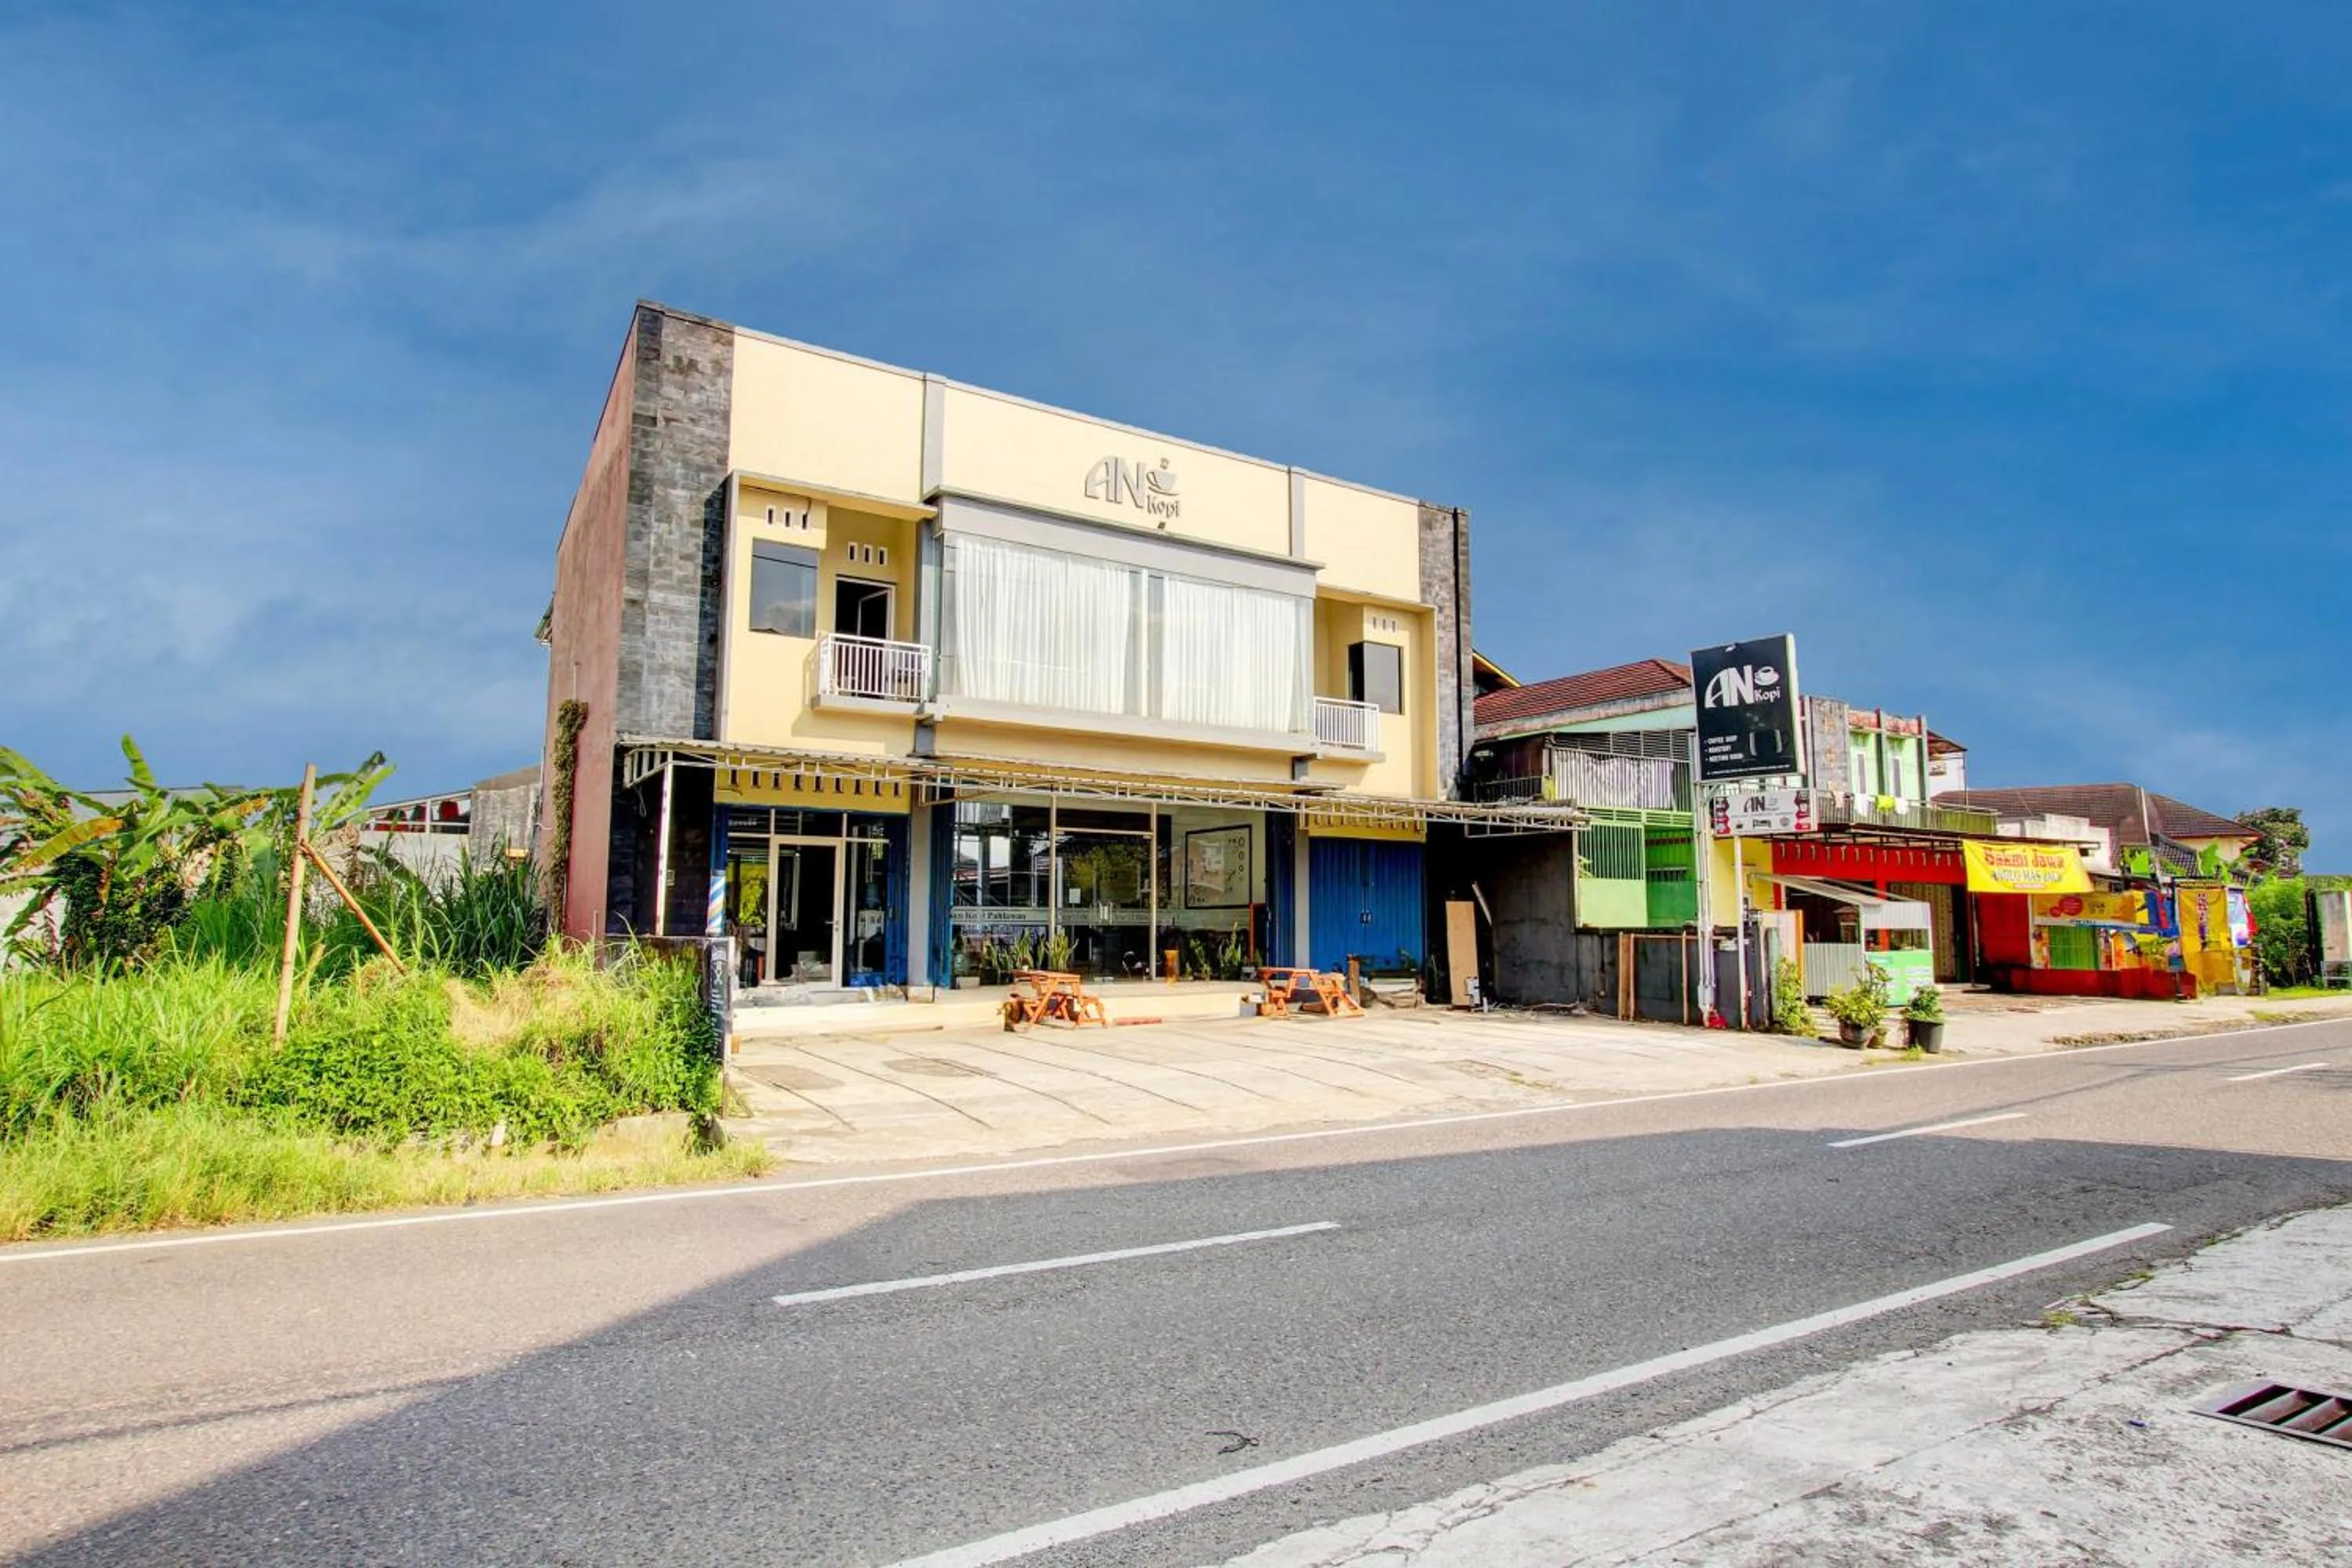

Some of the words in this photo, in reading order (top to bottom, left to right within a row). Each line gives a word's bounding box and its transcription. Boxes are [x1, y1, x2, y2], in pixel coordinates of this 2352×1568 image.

[1084, 456, 1147, 509] AN
[1704, 664, 1755, 709] AN
[1744, 796, 1766, 813] AN
